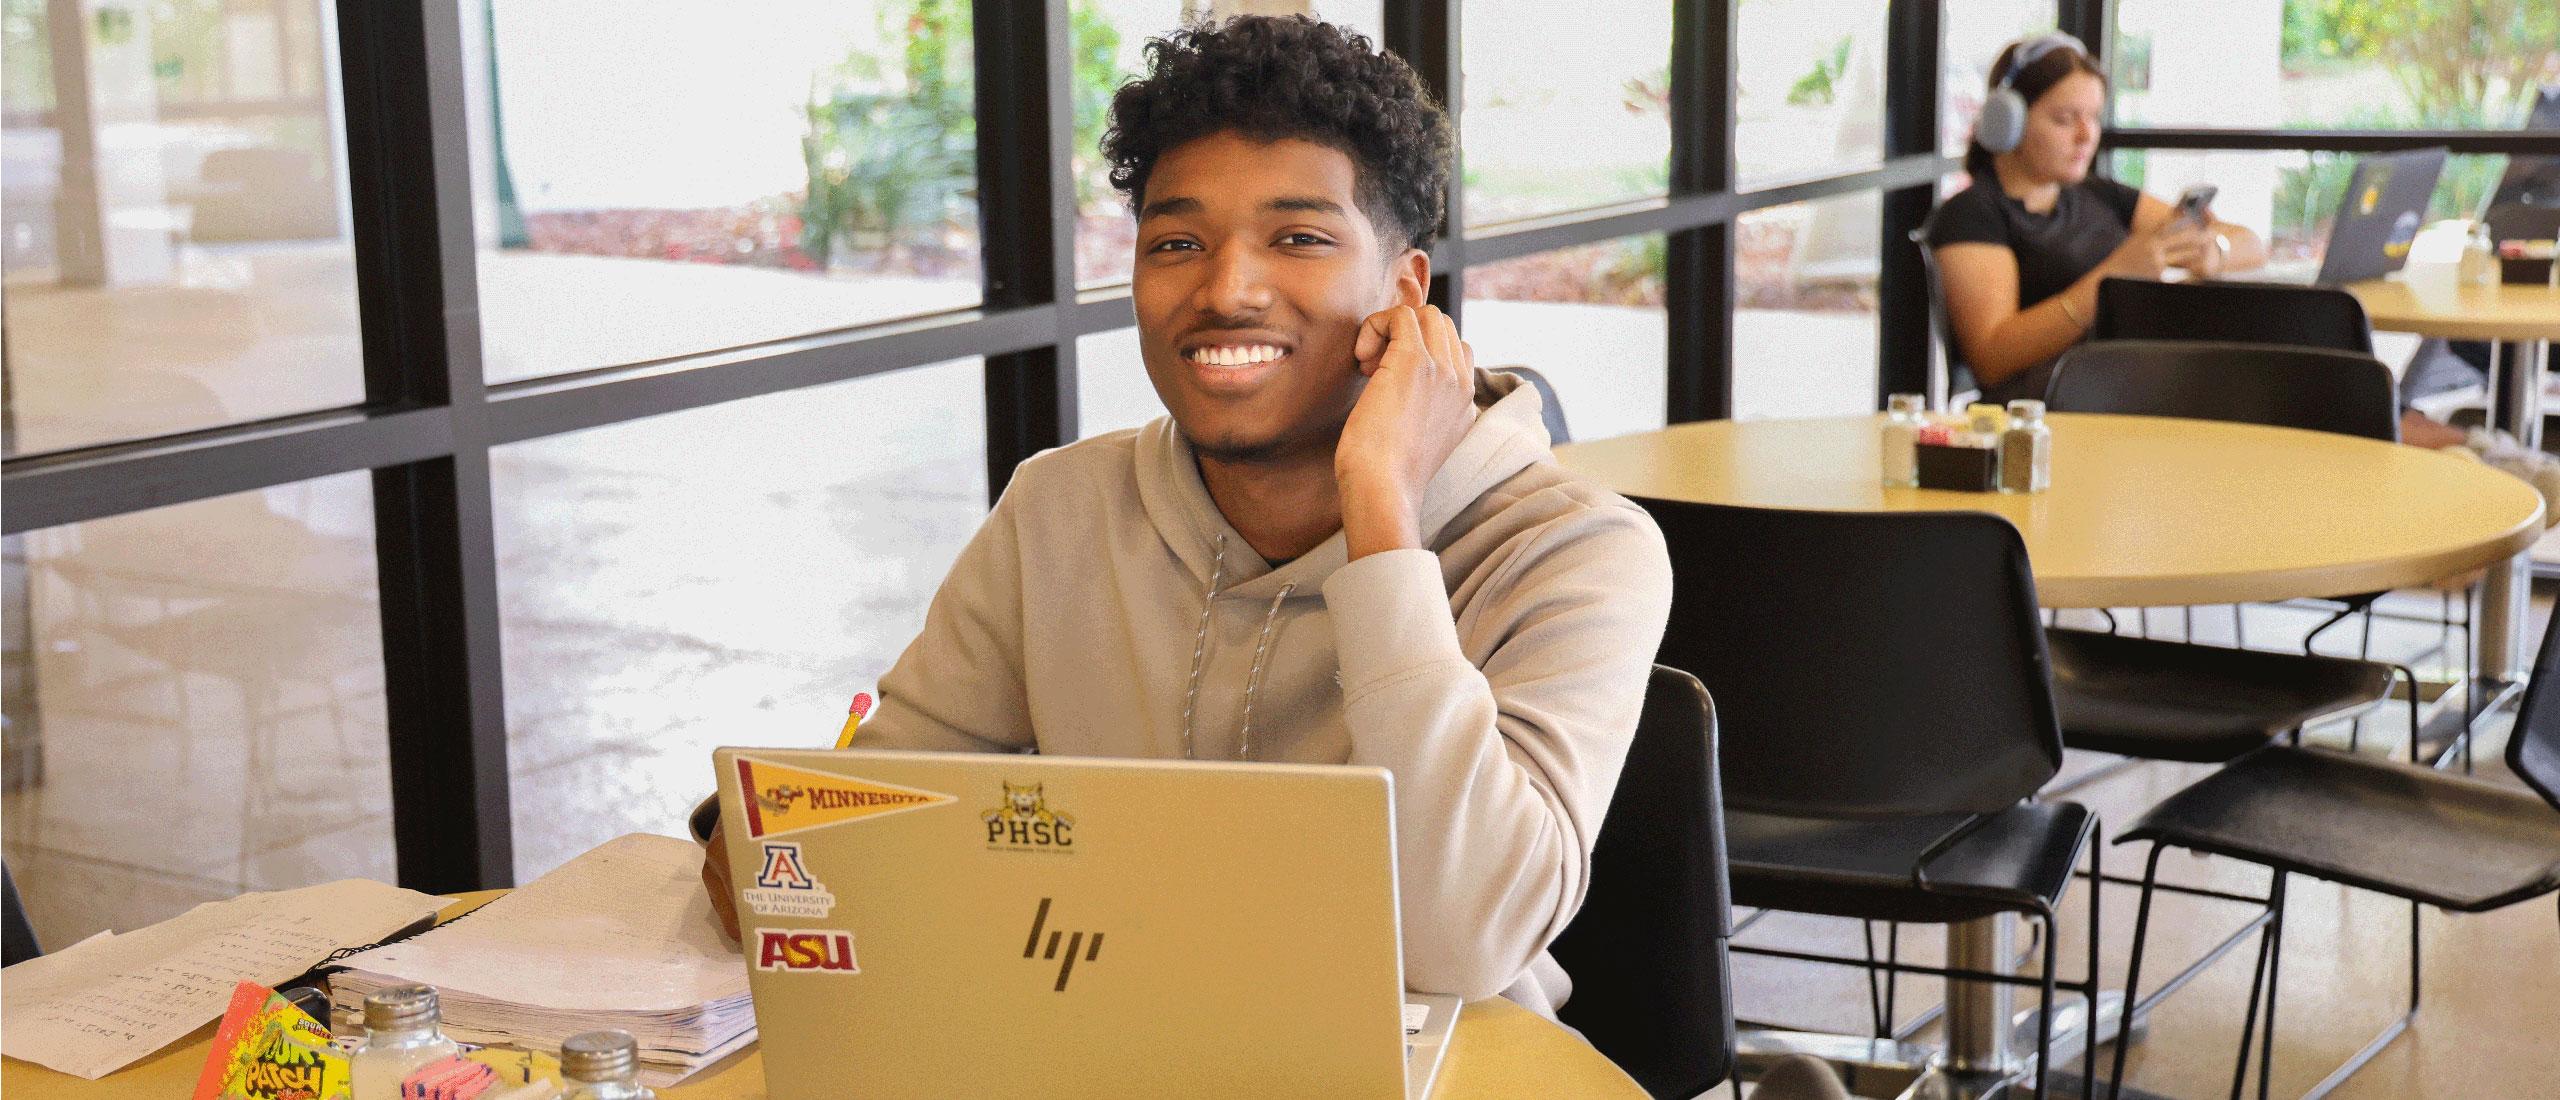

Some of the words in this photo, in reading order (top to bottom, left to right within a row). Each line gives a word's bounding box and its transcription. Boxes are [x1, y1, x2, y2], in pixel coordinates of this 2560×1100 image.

[987, 820, 1072, 846] PHSC
[758, 845, 813, 890] A
[745, 892, 763, 902] THE
[769, 893, 832, 906] UNIVERSITY
[755, 904, 768, 912] OF
[773, 904, 825, 916] ARIZONA
[761, 933, 856, 970] ASU
[1023, 898, 1104, 992] hp
[246, 1060, 321, 1095] PATCH
